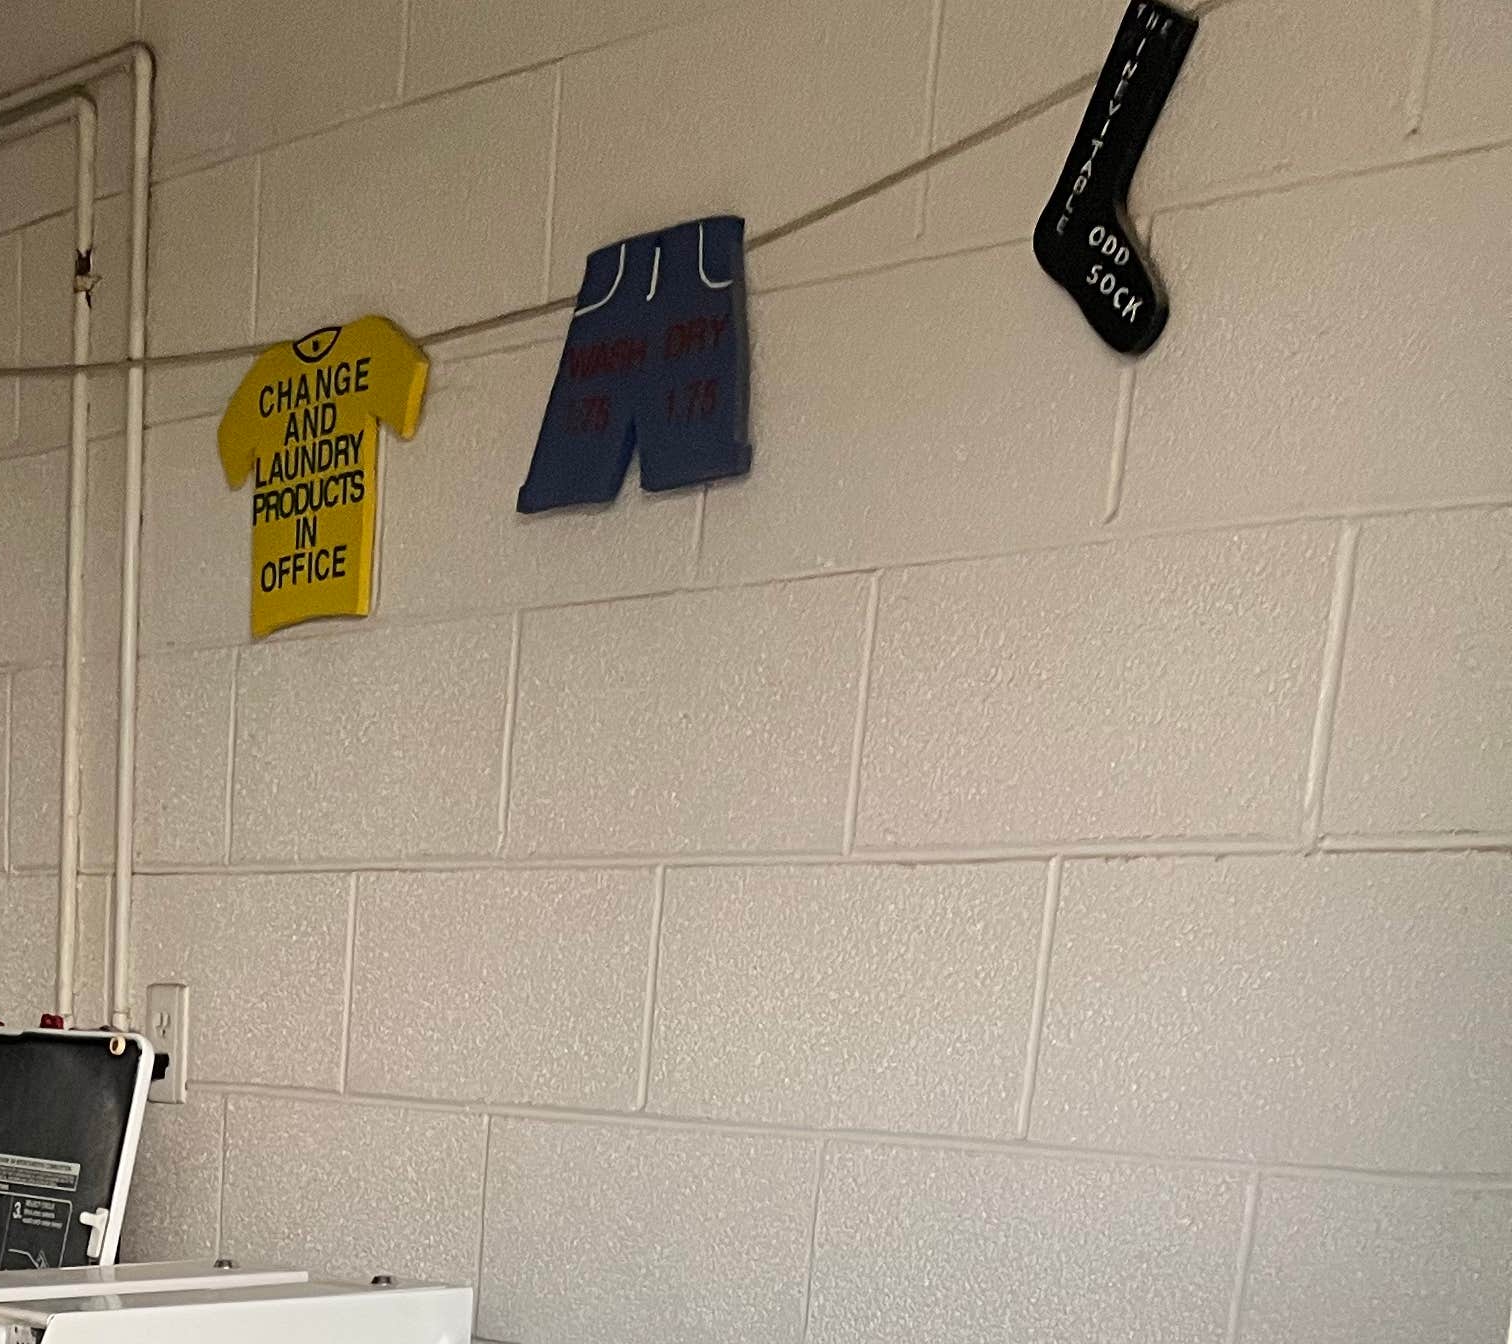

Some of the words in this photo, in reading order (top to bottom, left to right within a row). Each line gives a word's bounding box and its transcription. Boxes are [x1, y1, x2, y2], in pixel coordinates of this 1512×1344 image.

[1088, 225, 1130, 267] ODD
[1086, 264, 1143, 323] SOCK
[258, 356, 371, 418] CHANGE
[284, 402, 337, 446] AND
[255, 430, 364, 489] LAUNDRY
[252, 470, 365, 526] PRODUCTS
[295, 515, 317, 549] IN
[260, 545, 347, 592] OFFICE
